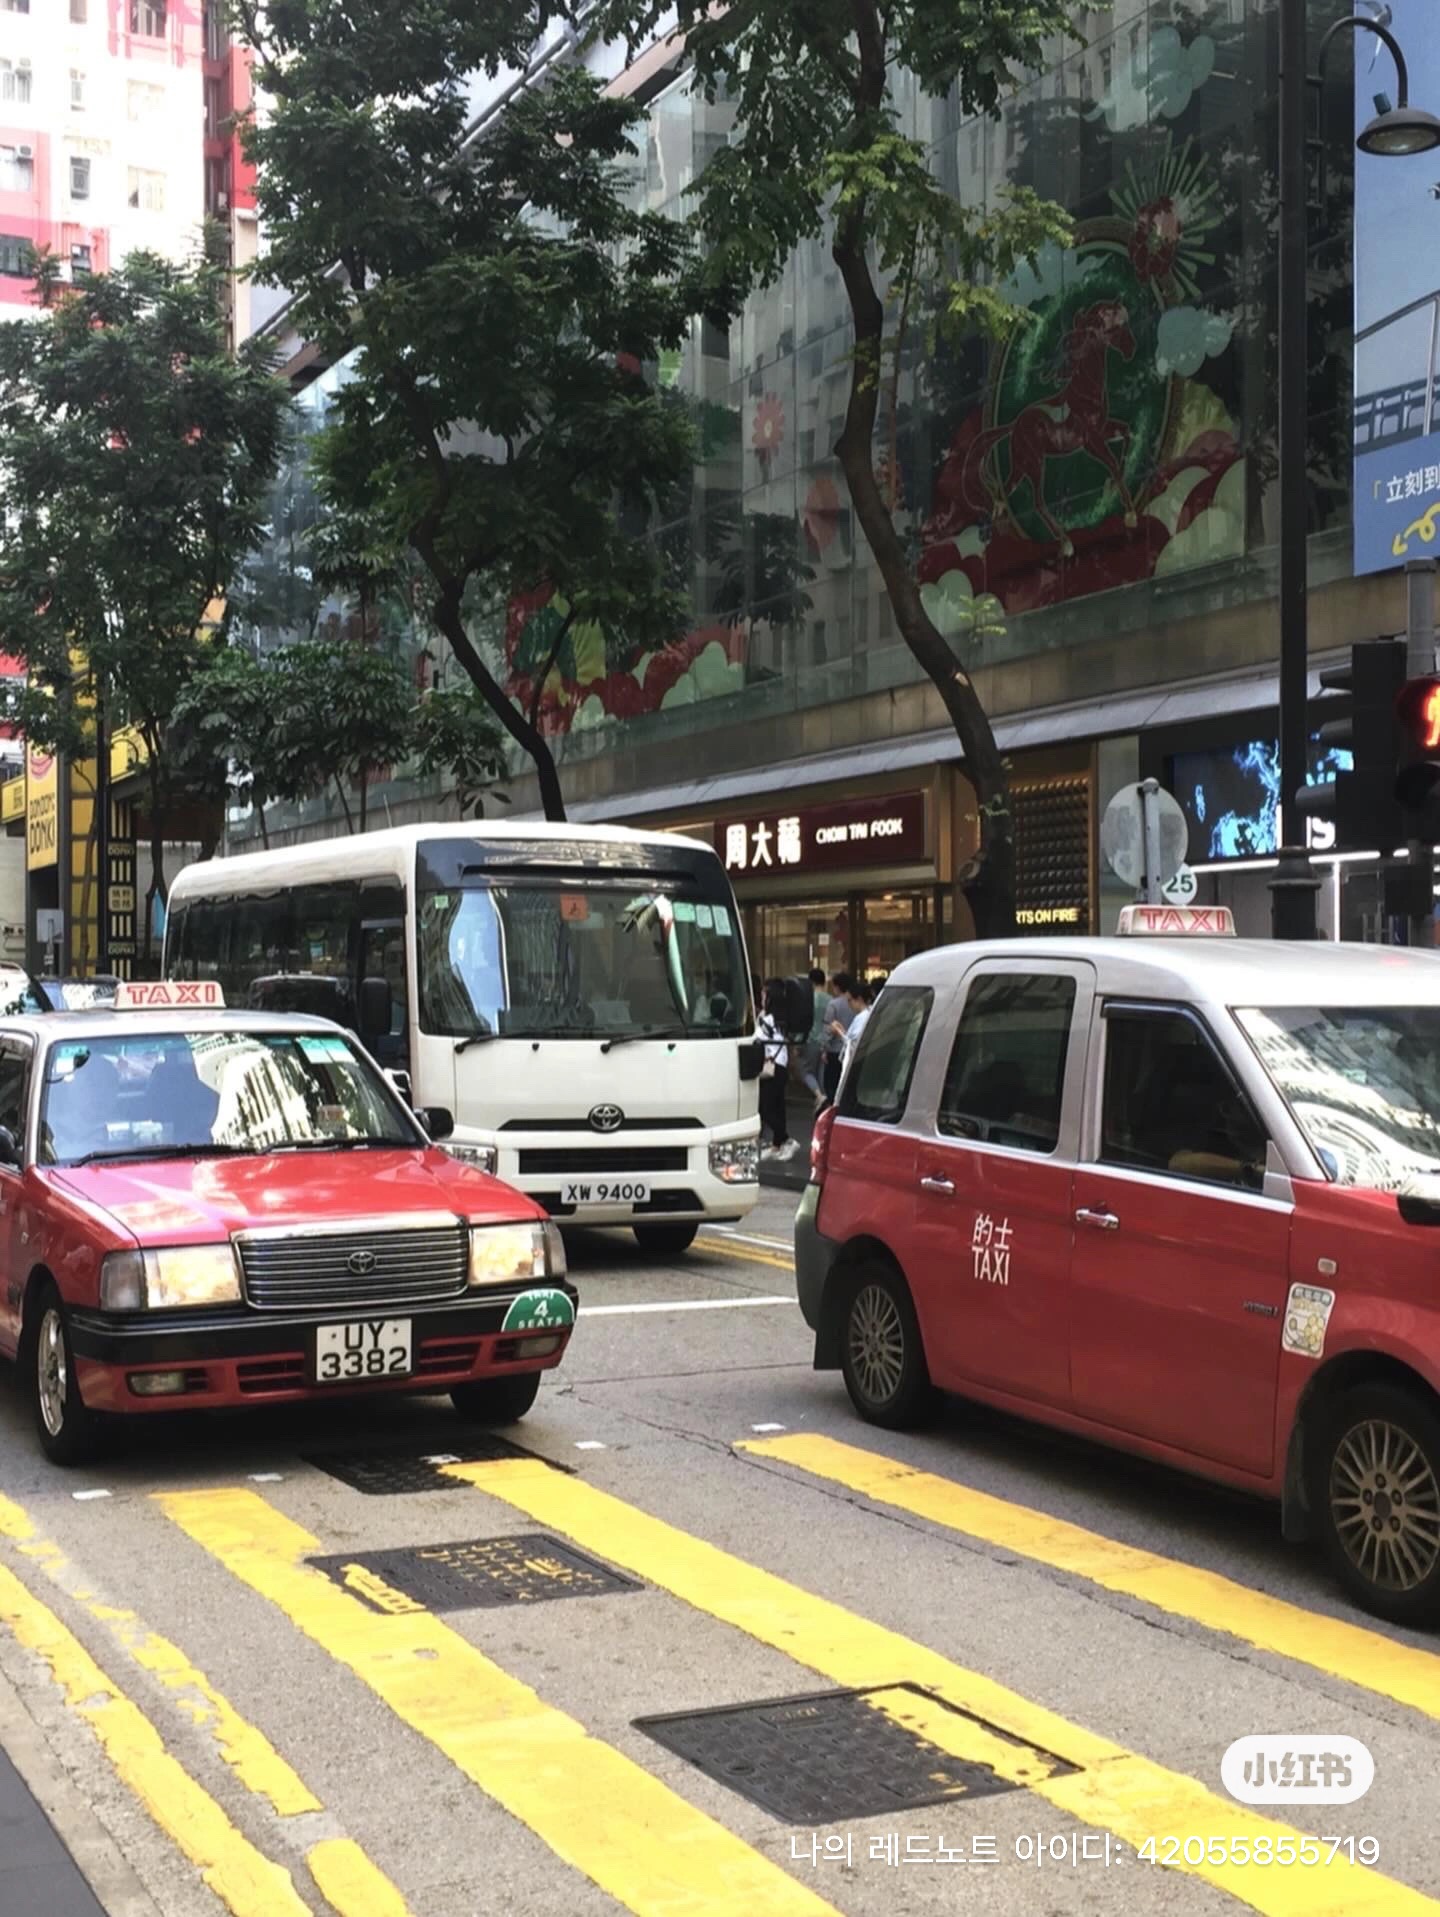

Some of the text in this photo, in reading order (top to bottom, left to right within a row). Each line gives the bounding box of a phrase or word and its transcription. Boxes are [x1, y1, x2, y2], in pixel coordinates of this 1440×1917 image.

[870, 818, 903, 838] FOOK
[725, 816, 801, 870] 周大福
[1035, 909, 1052, 923] ON
[1052, 908, 1078, 922] FIRE
[1140, 908, 1226, 932] TAXI
[127, 984, 216, 1004] TAXI
[567, 1183, 646, 1201] XW 9400
[972, 1213, 1013, 1250] 的士
[971, 1245, 1010, 1286] TAXI
[534, 1300, 549, 1317] 4
[344, 1321, 385, 1350] UY
[321, 1346, 407, 1379] 3382
